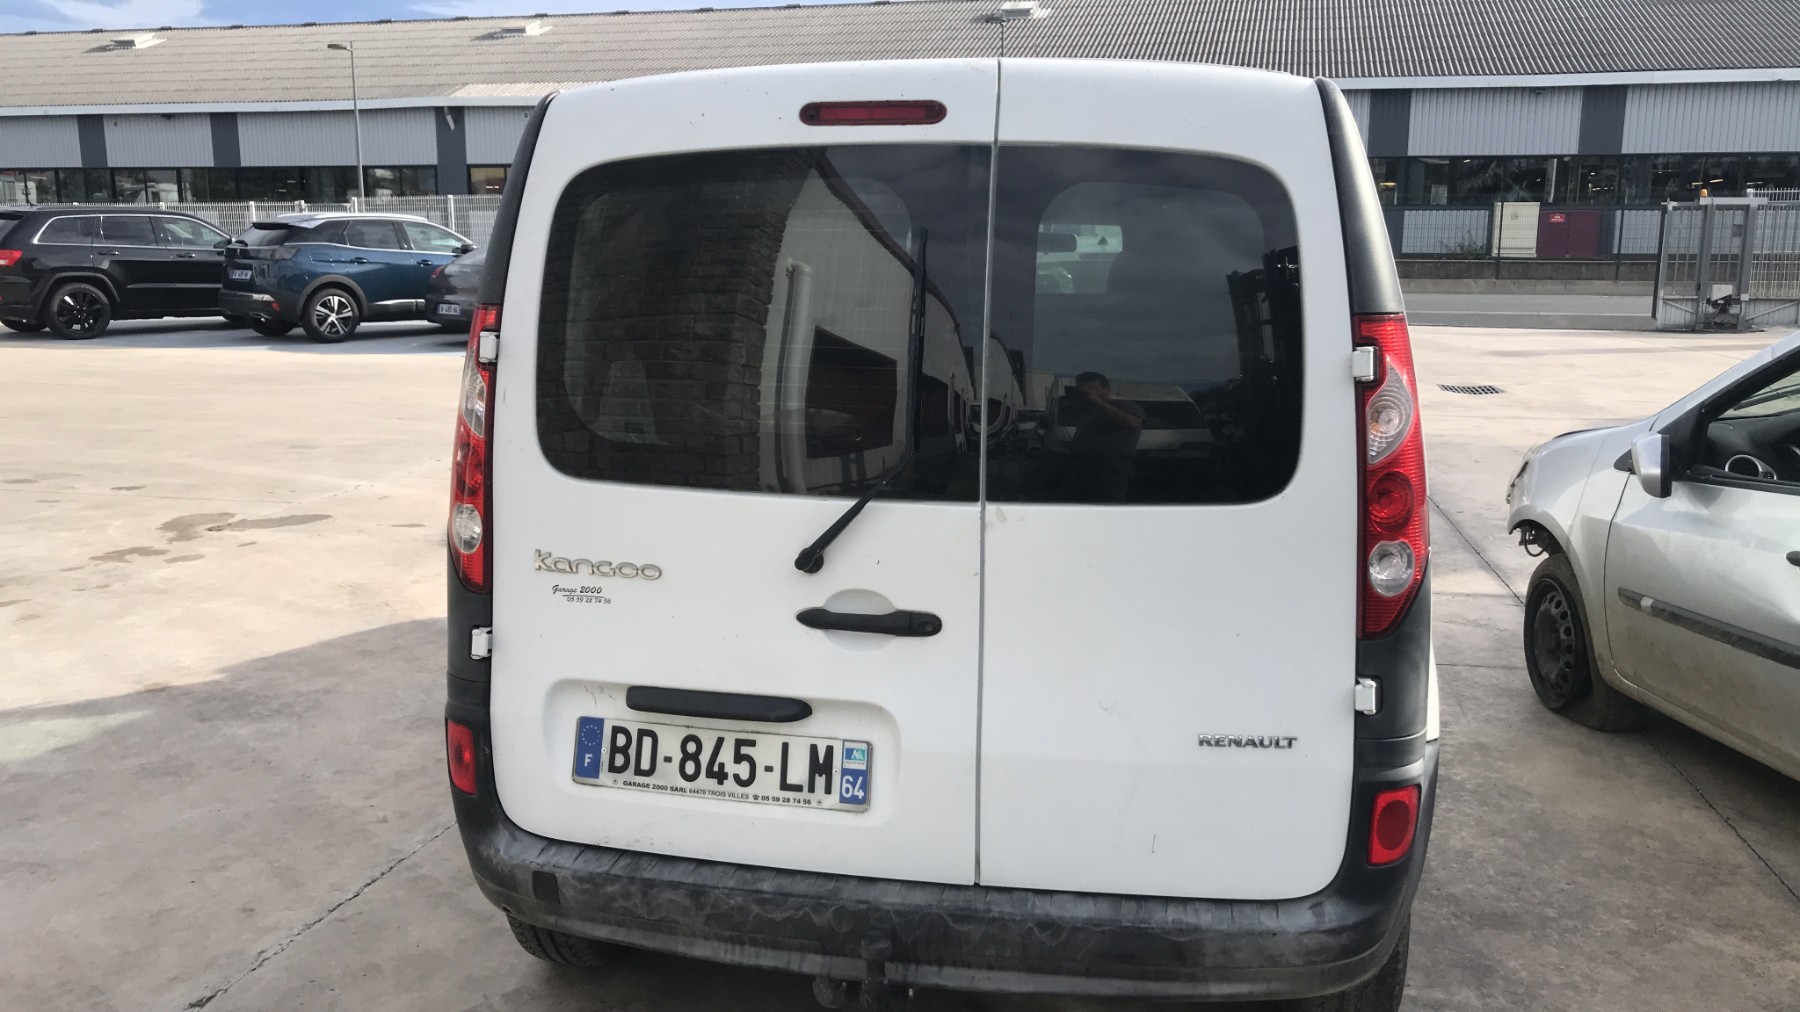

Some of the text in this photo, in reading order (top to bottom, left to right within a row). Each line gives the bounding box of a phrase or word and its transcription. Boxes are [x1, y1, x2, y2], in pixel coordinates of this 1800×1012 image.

[579, 585, 603, 595] 2000
[1198, 734, 1297, 749] RENAULT
[584, 754, 593, 767] F
[607, 725, 834, 794] BD-845-LM
[622, 780, 651, 789] GARAGE
[652, 784, 668, 792] 2000
[669, 785, 688, 794] SARL
[707, 790, 727, 798] TROIS
[727, 791, 750, 800] VILLES
[841, 775, 865, 800] 64
